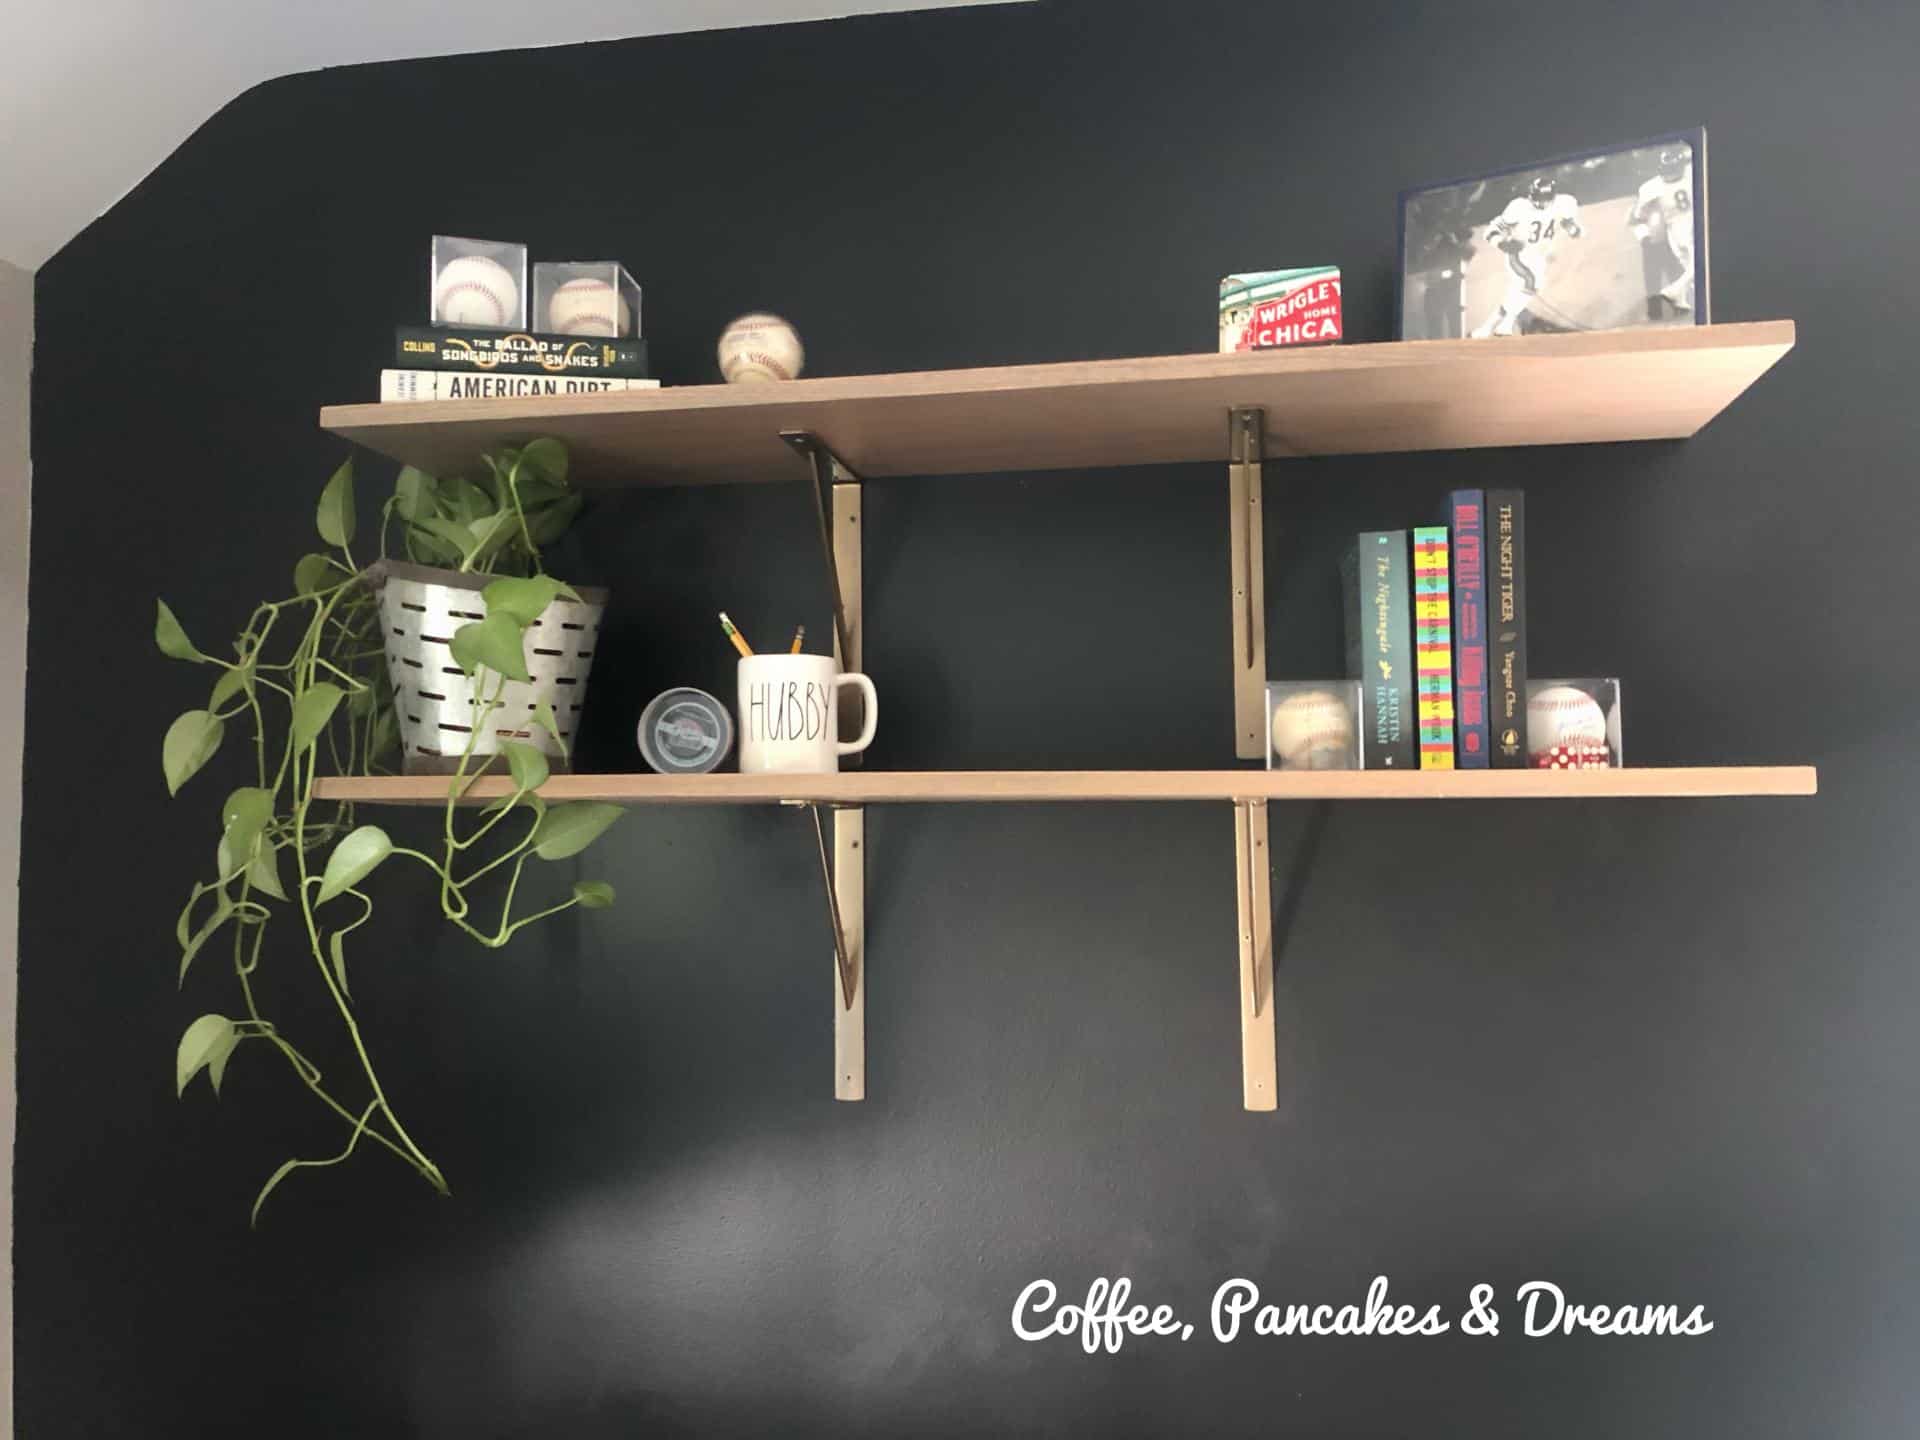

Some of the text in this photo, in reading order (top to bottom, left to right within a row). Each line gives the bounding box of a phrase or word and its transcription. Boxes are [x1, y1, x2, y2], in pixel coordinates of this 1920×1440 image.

[1528, 219, 1555, 243] 34
[1303, 307, 1337, 321] HOME
[1258, 318, 1338, 346] CHICA
[474, 339, 565, 353] THE BALLAD OF
[442, 349, 519, 364] SONGBIRDS
[523, 353, 543, 363] AND
[544, 354, 598, 368] SNAKES
[450, 376, 557, 399] AMERICAN
[1377, 554, 1390, 578] The
[1500, 504, 1514, 623] THE NIGHT TIGER
[1427, 592, 1438, 609] THE
[749, 681, 832, 743] HUBBY
[1376, 686, 1388, 744] HANNAH
[1388, 686, 1401, 742] KRISTIN
